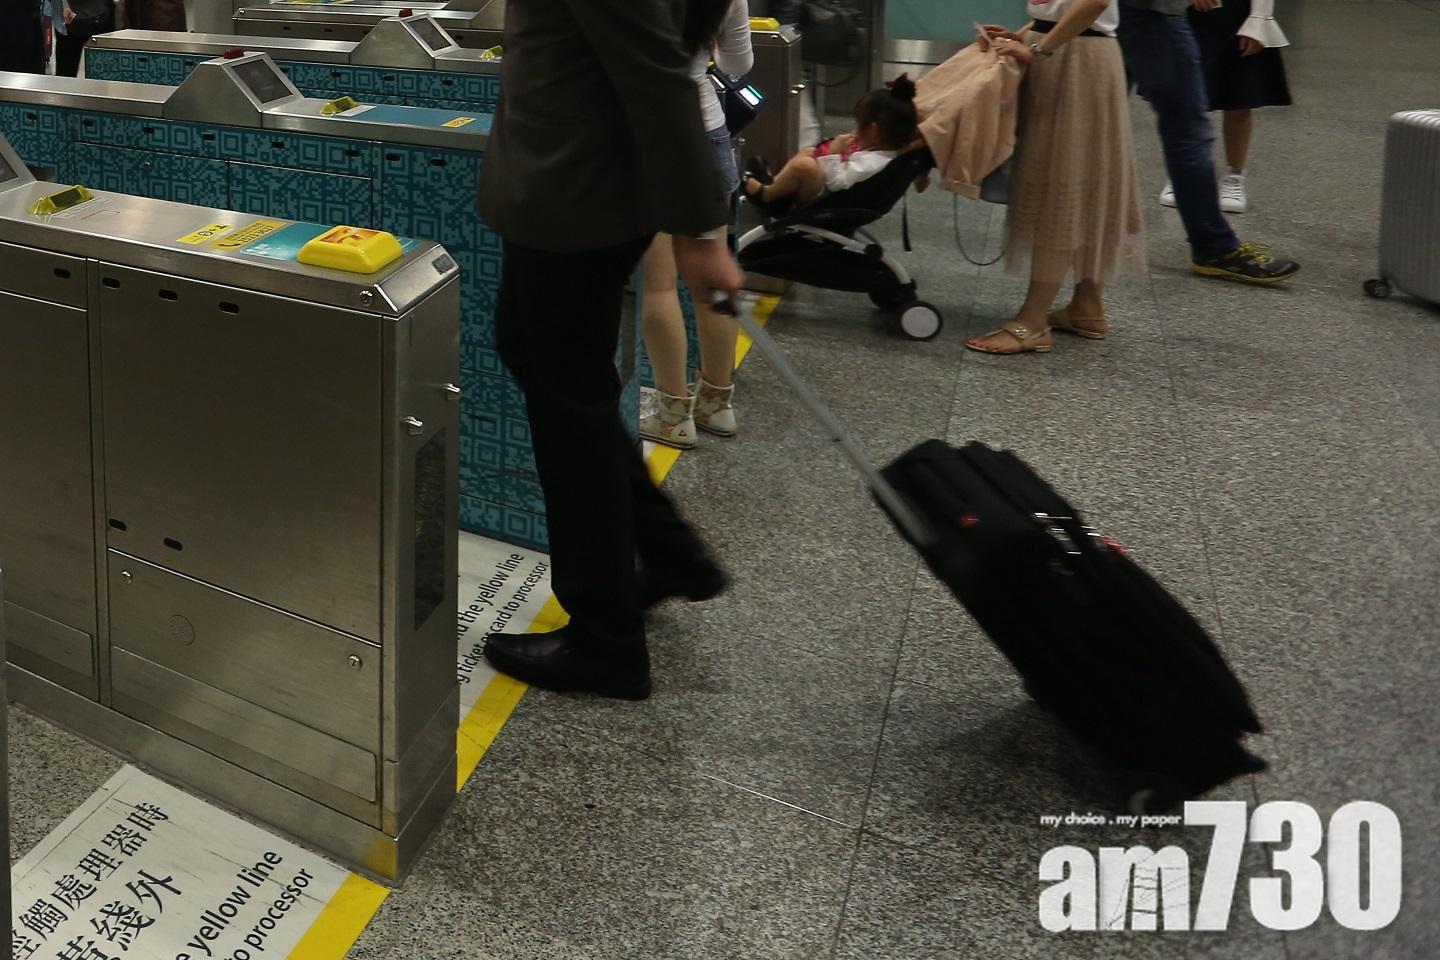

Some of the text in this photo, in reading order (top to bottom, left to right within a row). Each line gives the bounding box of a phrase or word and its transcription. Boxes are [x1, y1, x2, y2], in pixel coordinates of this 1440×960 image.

[475, 570, 509, 606] yellow
[496, 553, 524, 572] line
[490, 610, 512, 632] card
[502, 600, 520, 612] to
[513, 561, 549, 603] processor
[187, 851, 283, 957] yellow line
[244, 868, 314, 951] processor
